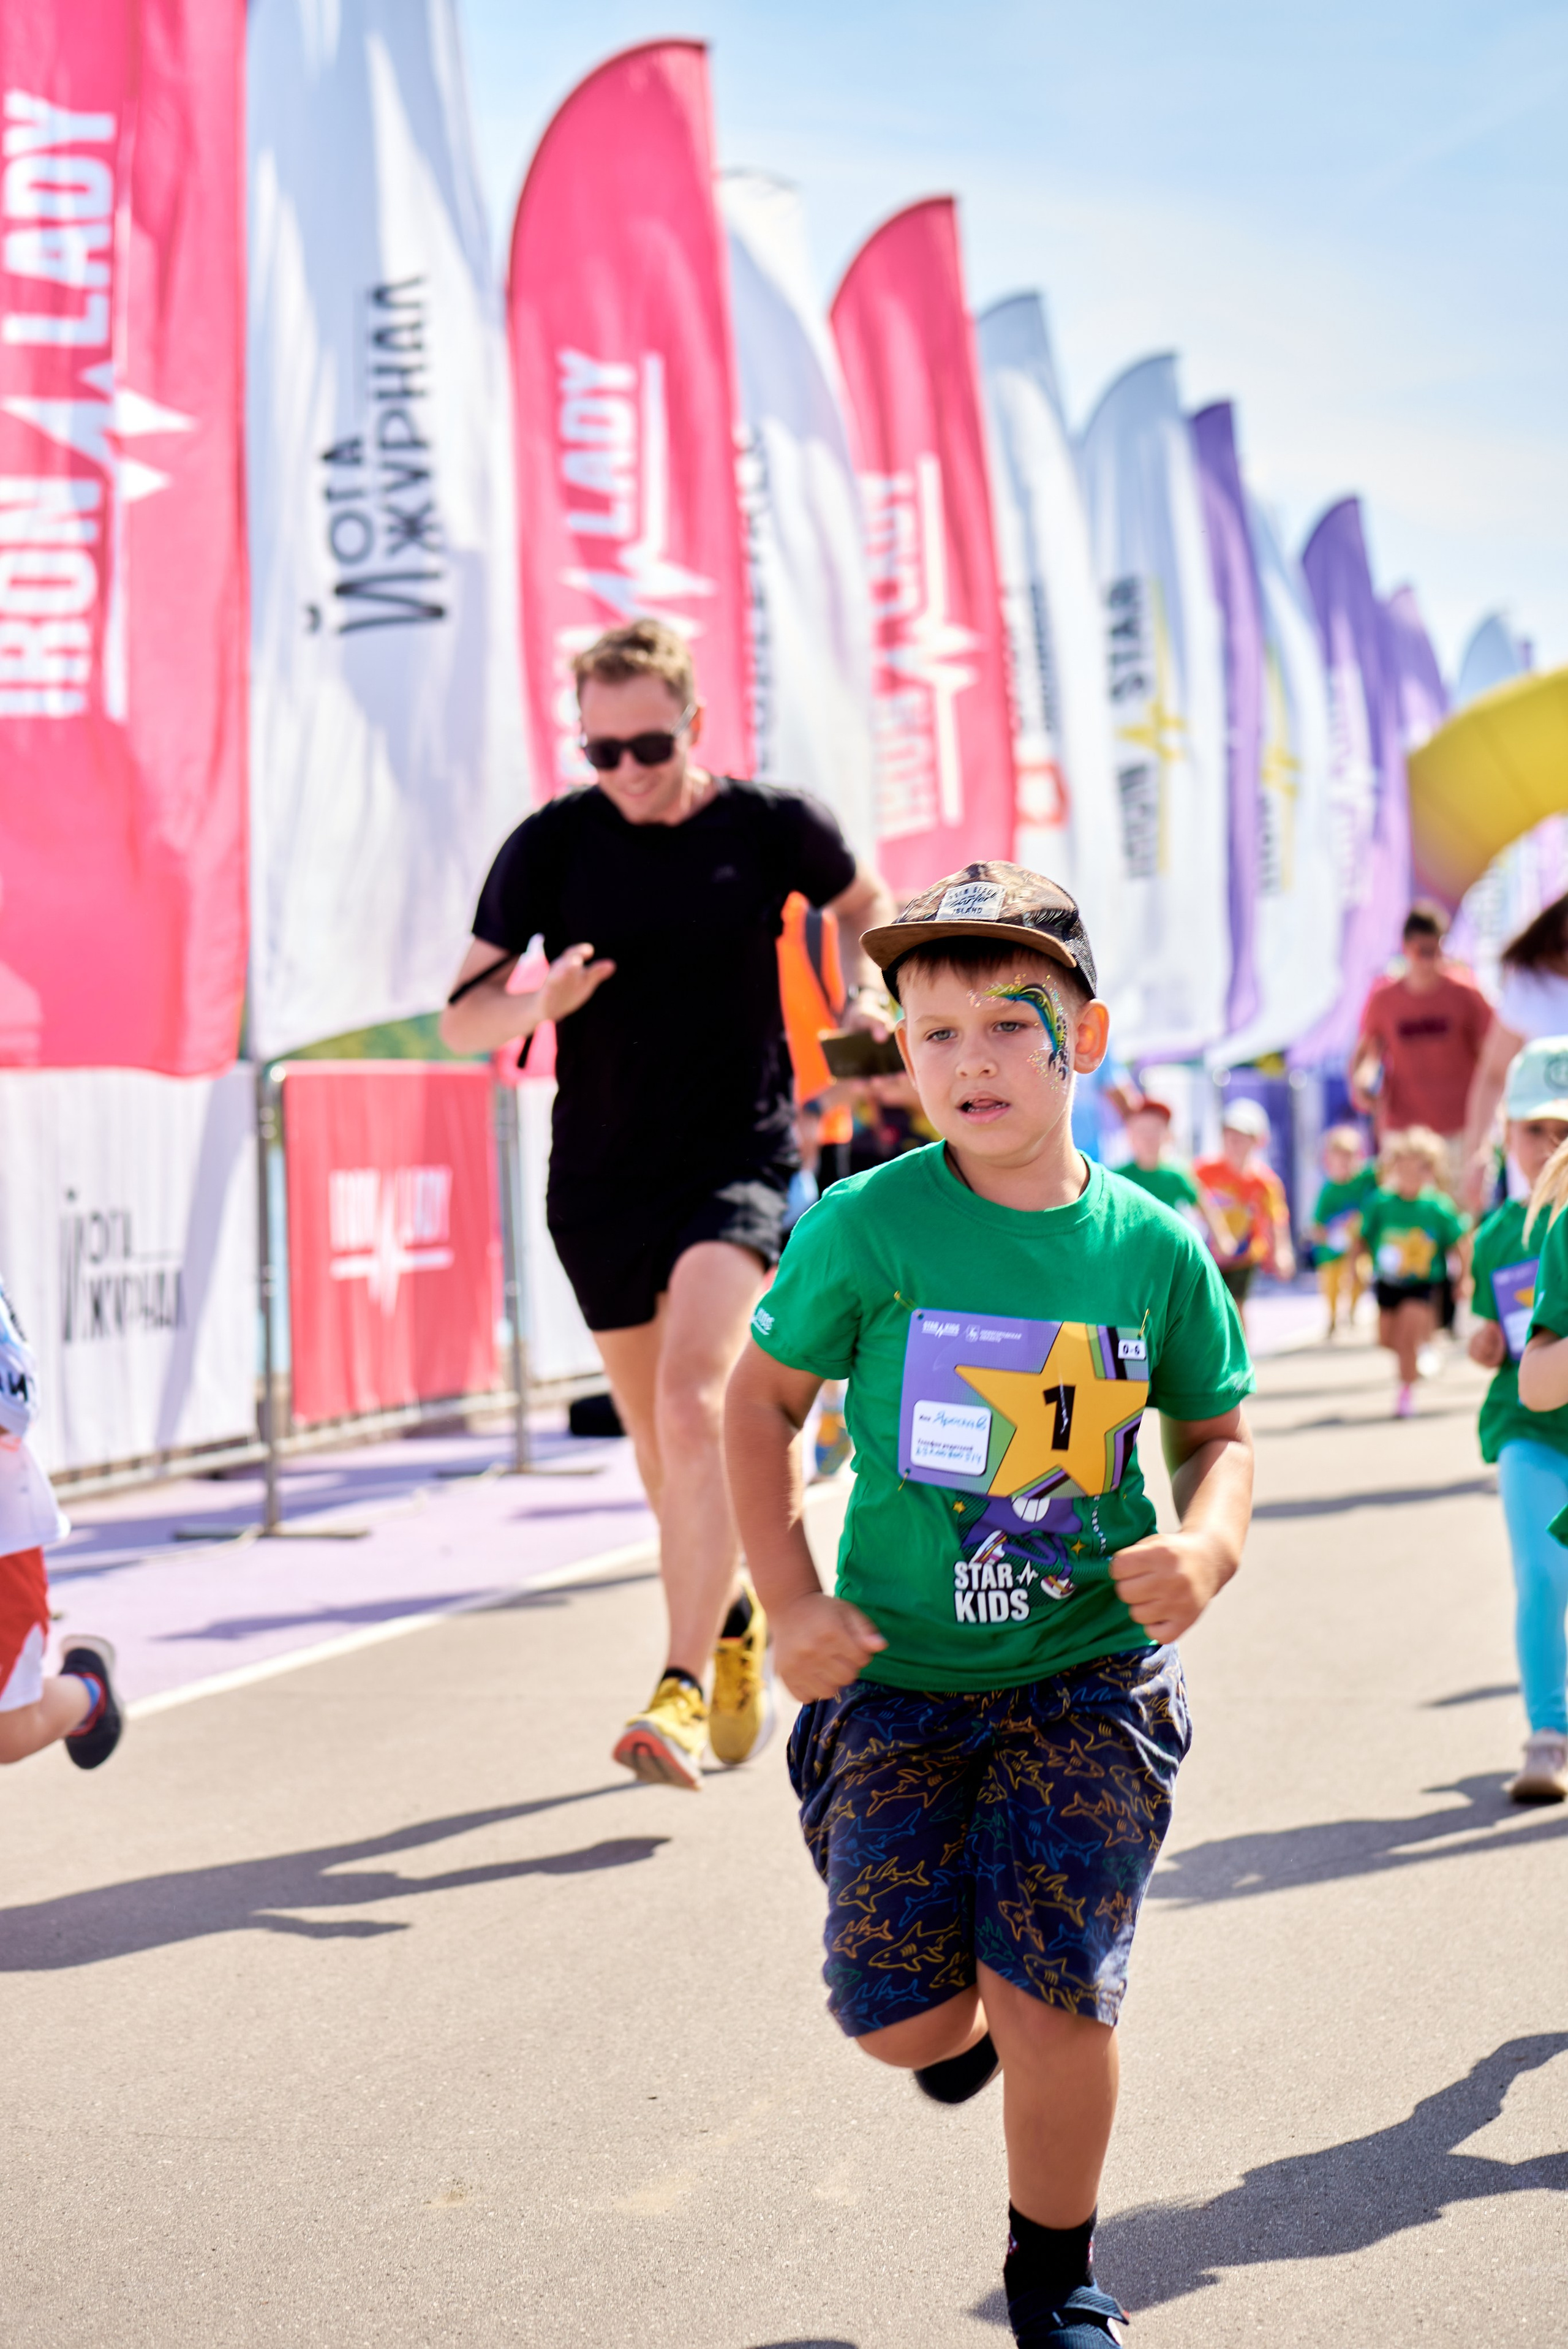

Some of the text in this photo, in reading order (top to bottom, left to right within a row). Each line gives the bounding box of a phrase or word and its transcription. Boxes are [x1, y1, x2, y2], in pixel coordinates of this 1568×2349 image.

[2, 89, 116, 347] LADY
[557, 348, 639, 540] LADY
[1043, 1384, 1076, 1450] 1
[954, 1561, 1013, 1591] STAR
[954, 1588, 1030, 1623] KIDS
